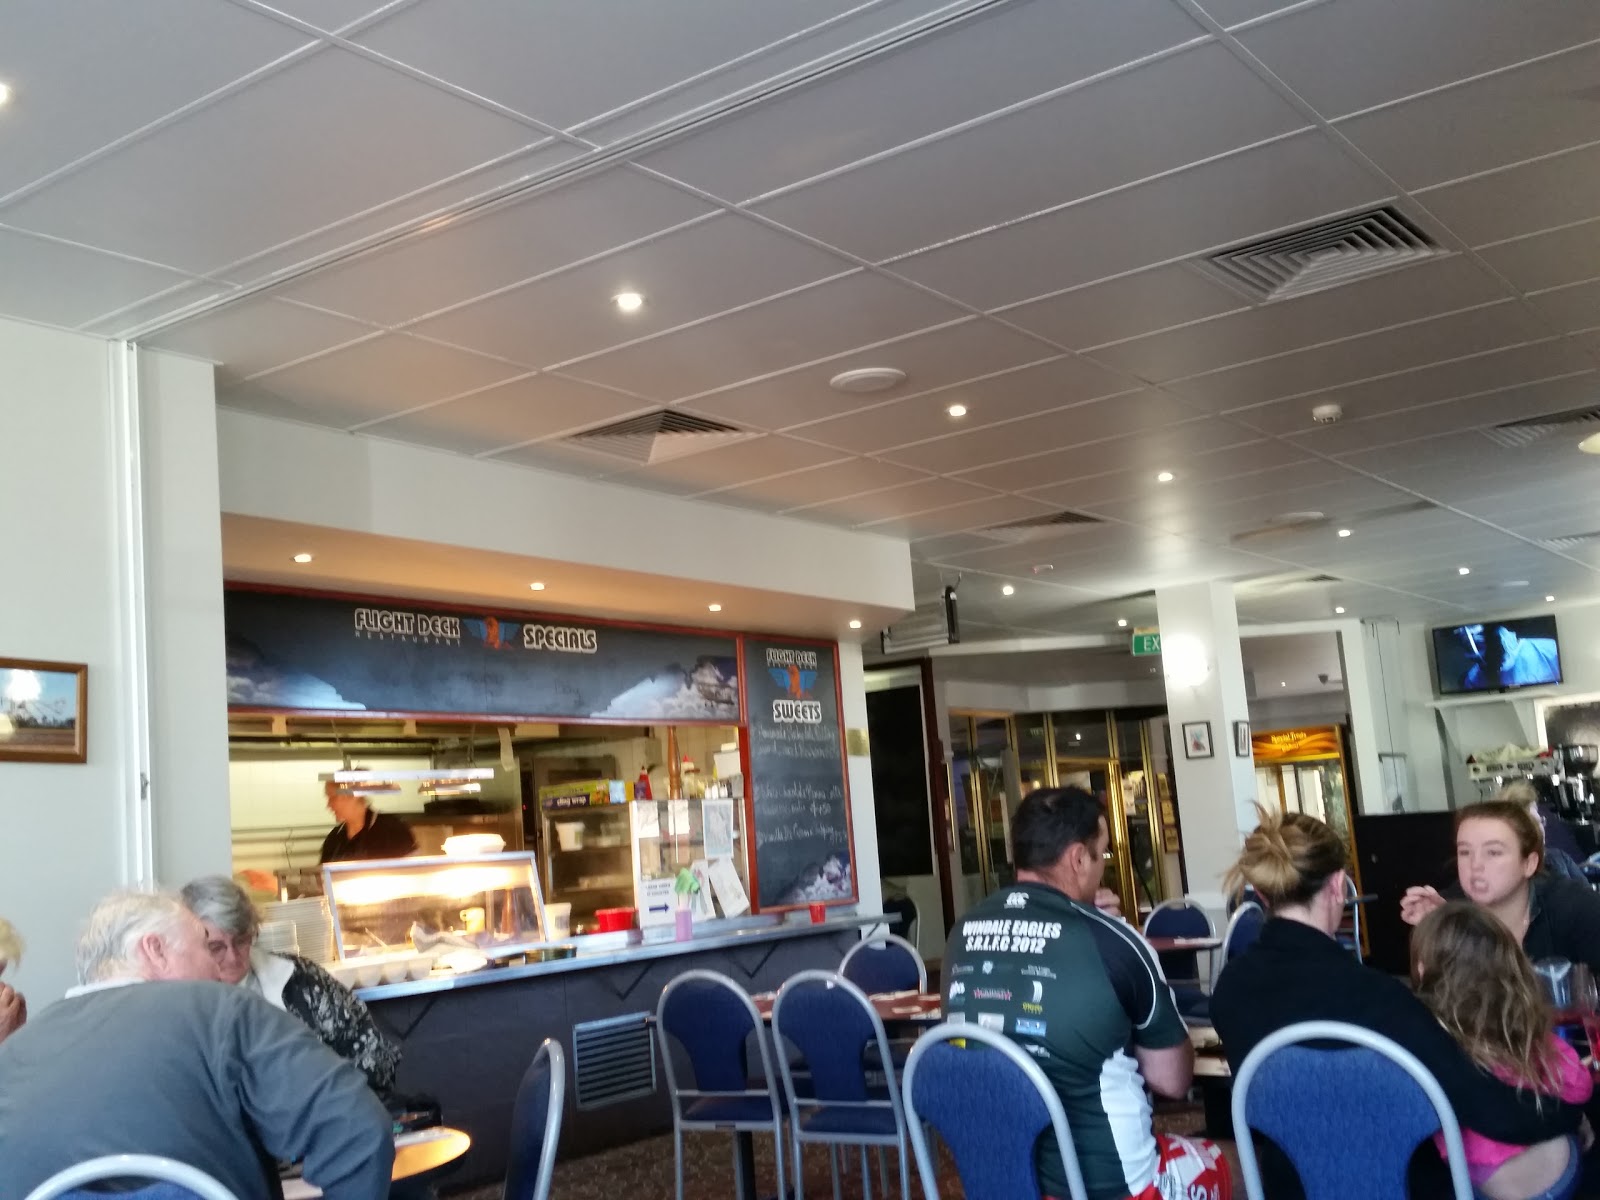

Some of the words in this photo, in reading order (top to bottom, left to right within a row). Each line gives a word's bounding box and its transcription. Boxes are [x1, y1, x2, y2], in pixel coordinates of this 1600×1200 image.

[354, 607, 415, 635] FLIGHT
[417, 613, 461, 638] DECK
[523, 623, 597, 654] SPECIALS
[1143, 635, 1160, 651] EX
[772, 699, 822, 724] SWEETS
[1011, 920, 1062, 939] EAGLES
[1010, 936, 1046, 954] 2012
